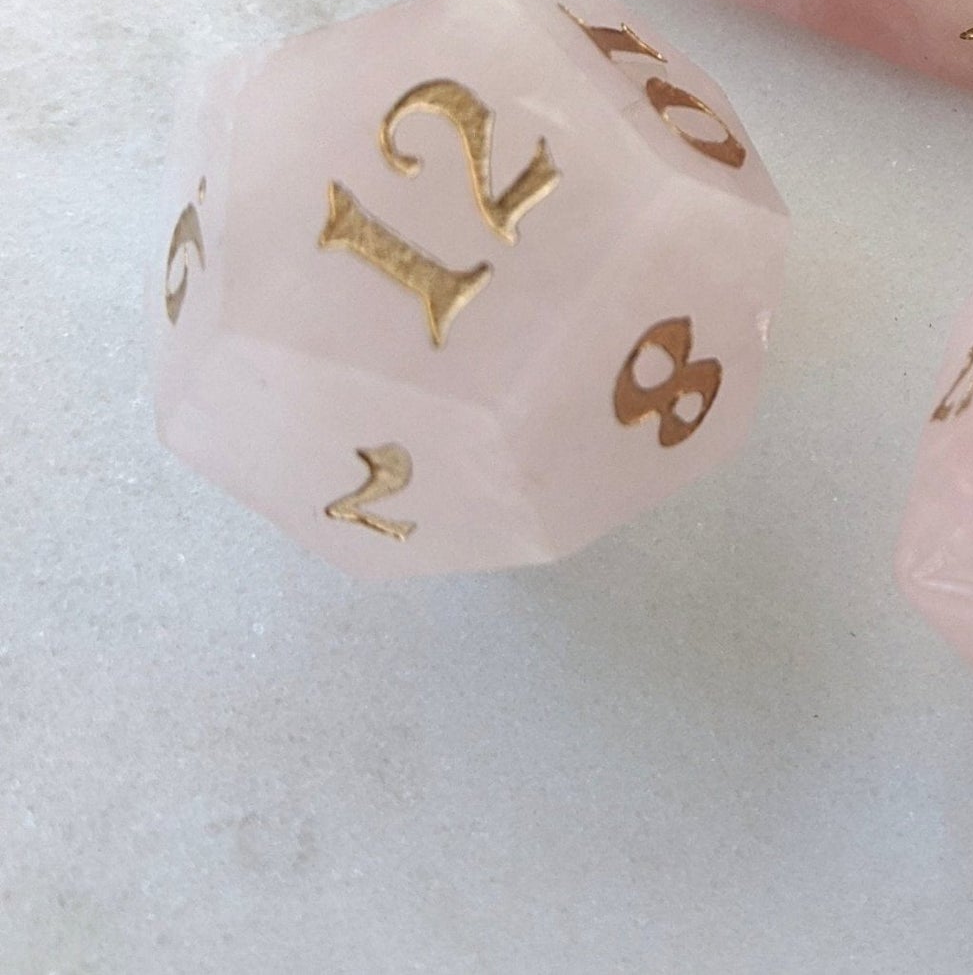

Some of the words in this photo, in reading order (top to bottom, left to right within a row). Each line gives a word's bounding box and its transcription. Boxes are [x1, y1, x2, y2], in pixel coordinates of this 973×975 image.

[555, 2, 748, 169] 10
[316, 78, 562, 350] 12
[614, 316, 722, 447] 8
[324, 441, 418, 542] 2
